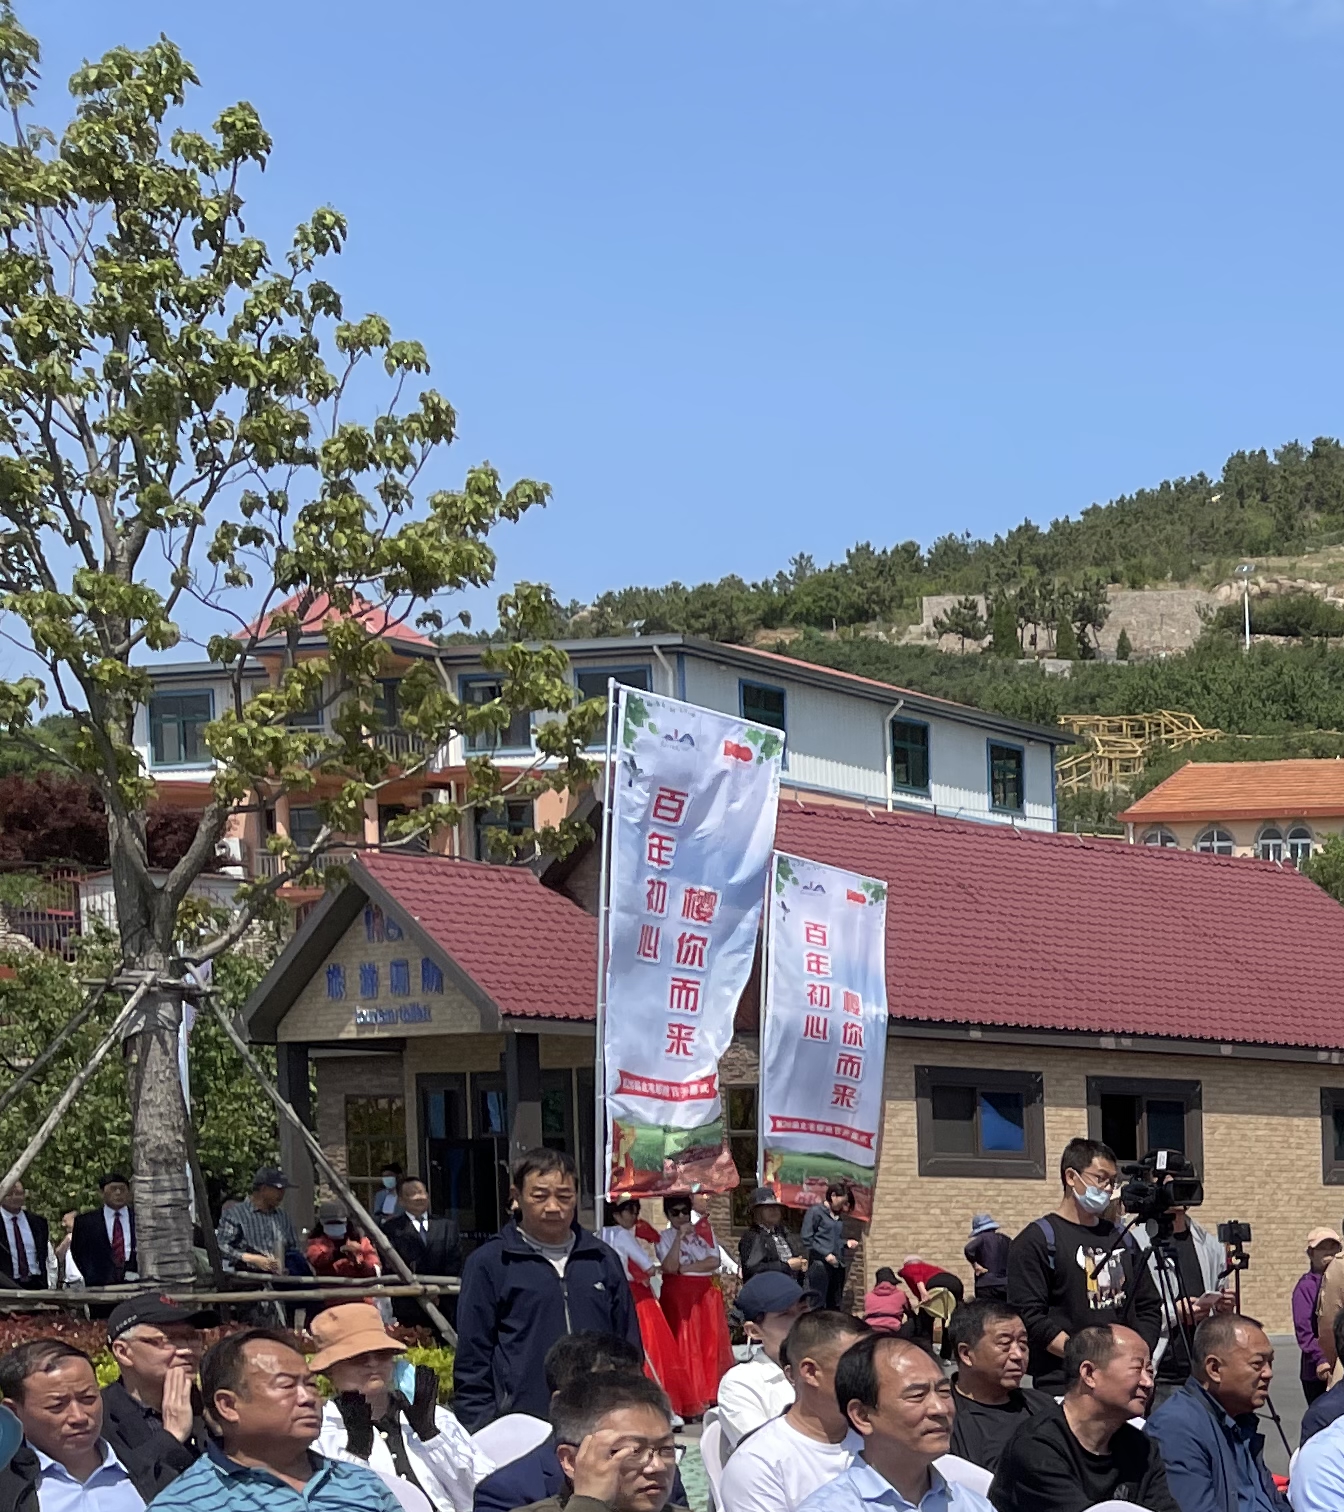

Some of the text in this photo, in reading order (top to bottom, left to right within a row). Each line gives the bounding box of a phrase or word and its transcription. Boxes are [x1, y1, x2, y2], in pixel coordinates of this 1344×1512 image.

[637, 787, 689, 961] 百年初心
[664, 888, 718, 1057] 樱你而来
[802, 920, 830, 1043] 百年初心
[831, 990, 864, 1109] 樱你而来
